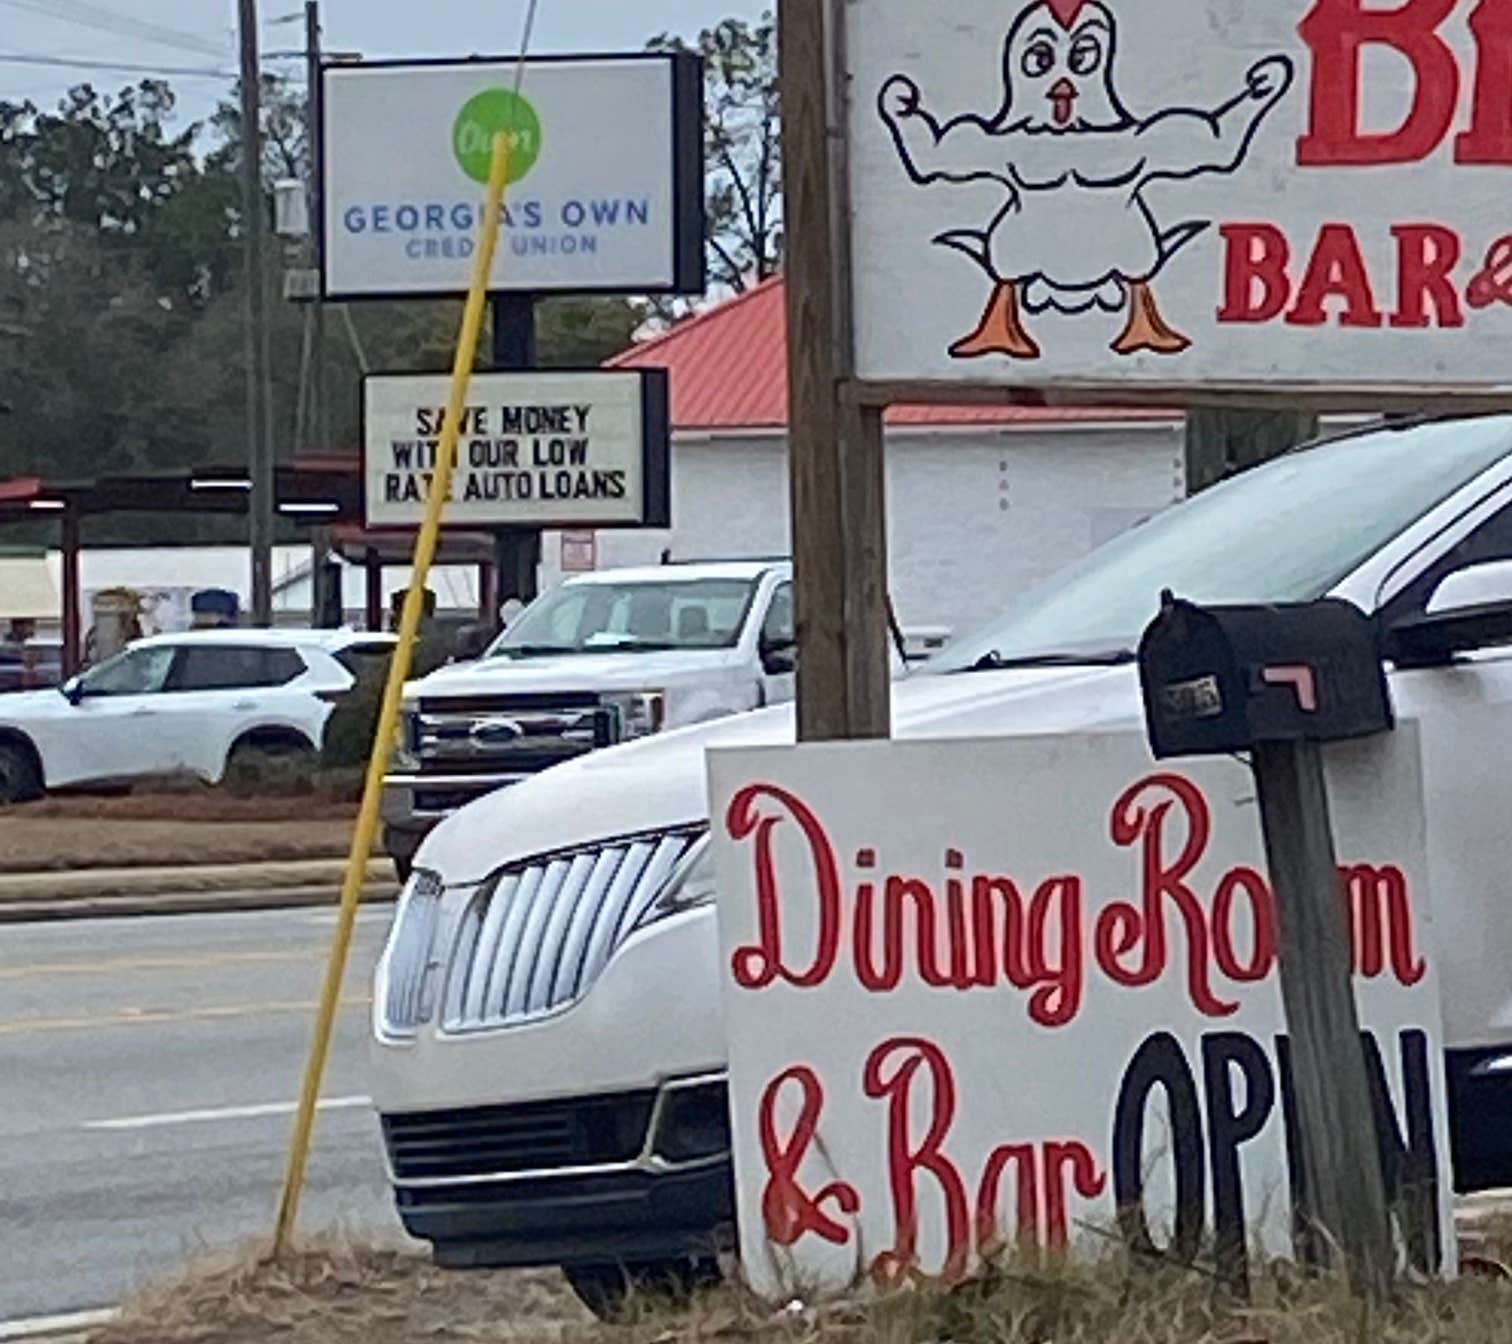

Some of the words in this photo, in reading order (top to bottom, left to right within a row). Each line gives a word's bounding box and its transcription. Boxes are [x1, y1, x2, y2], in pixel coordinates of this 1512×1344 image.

[561, 198, 648, 227] OWN
[405, 236, 495, 260] CRED
[511, 234, 597, 257] UNION
[503, 405, 592, 434] MONEY
[469, 440, 518, 468] OUR
[533, 438, 589, 465] LOW
[463, 473, 533, 500] AUTO
[539, 470, 626, 499] LOANS
[726, 784, 1080, 1026] Dining
[1096, 772, 1426, 1016] Rom
[758, 1066, 860, 1245] &
[863, 1038, 1106, 1288] Bar
